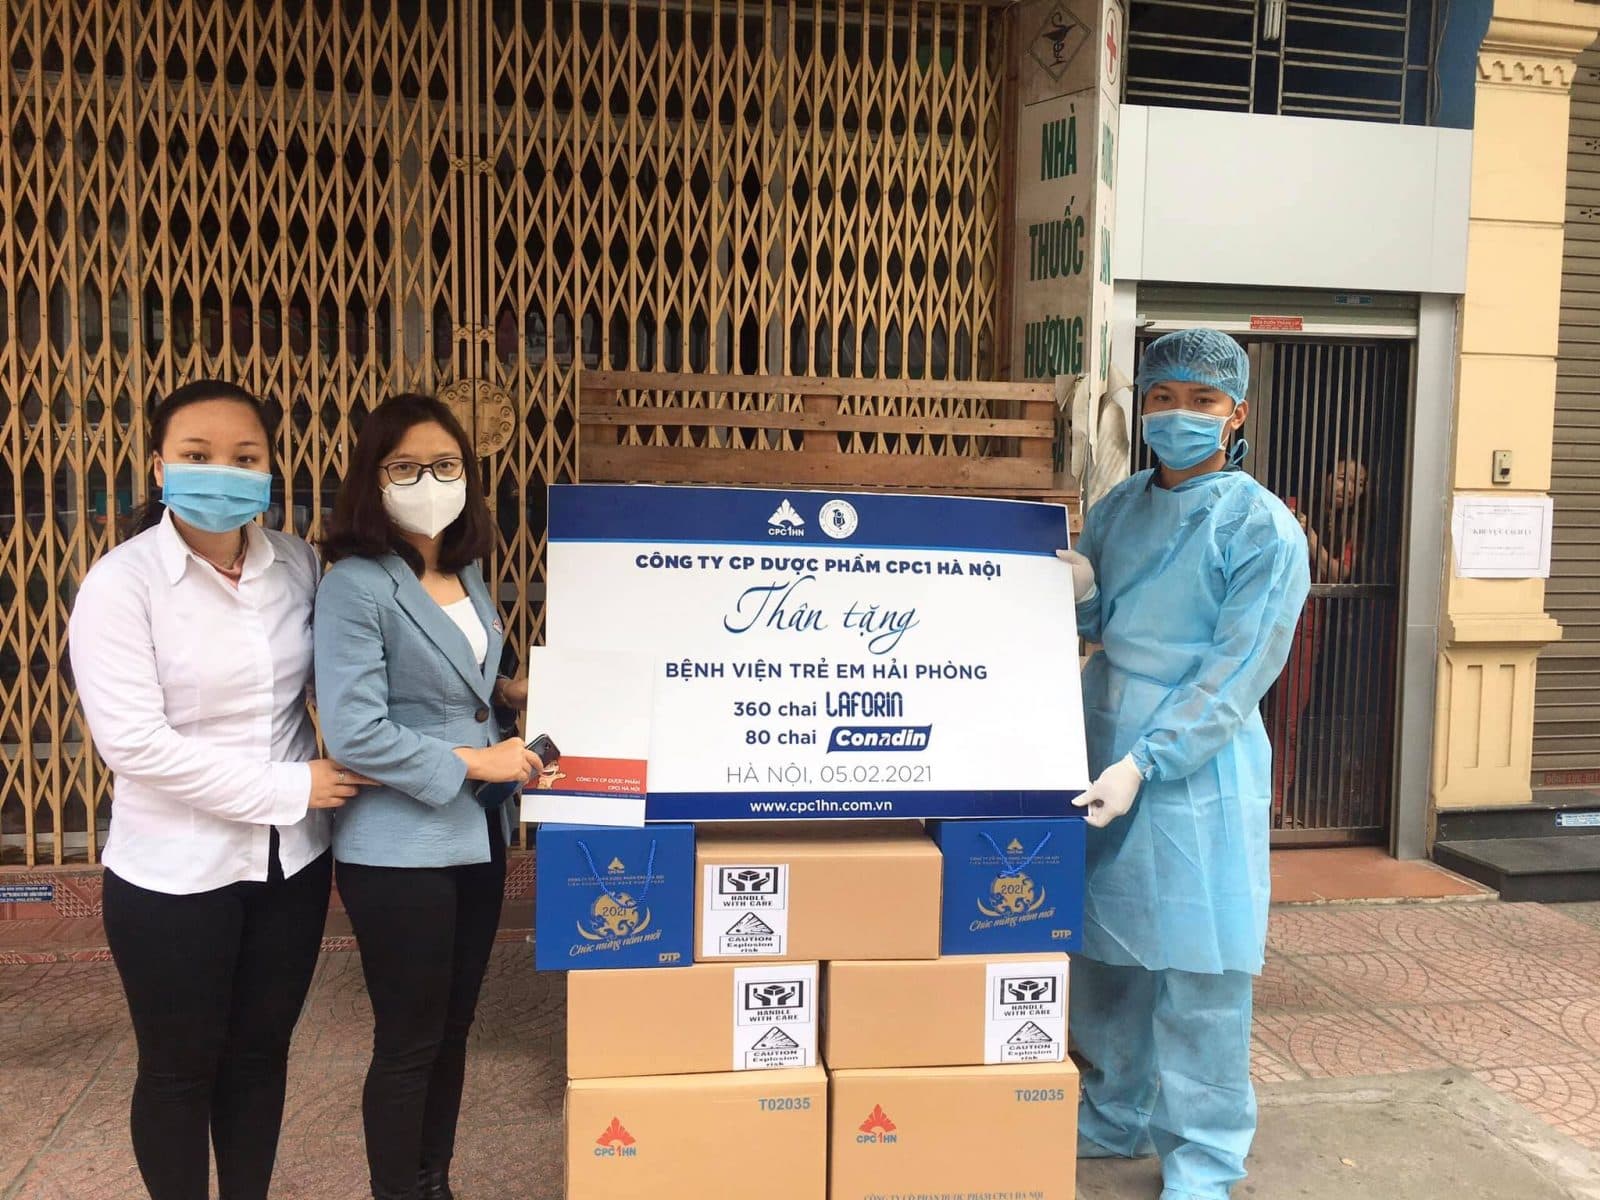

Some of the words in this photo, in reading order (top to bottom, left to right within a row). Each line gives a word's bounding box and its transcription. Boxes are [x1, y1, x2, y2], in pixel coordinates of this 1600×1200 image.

[1041, 103, 1077, 181] NHÀ
[1029, 195, 1085, 281] THUỐC
[1024, 315, 1084, 378] HƯƠNG
[768, 526, 804, 536] CPC1HN
[635, 552, 693, 569] CÔNG
[698, 555, 723, 570] TY
[729, 556, 755, 571] CP
[760, 555, 819, 576] DƯỢC
[885, 560, 932, 575] CPC1
[937, 558, 964, 576] HÀ
[969, 559, 1002, 581] NỘI
[723, 575, 829, 634] Thân
[843, 600, 921, 655] tặng
[665, 658, 725, 685] BỆNH
[731, 658, 782, 685] VIỆN
[789, 656, 830, 680] TRẺ
[836, 664, 865, 680] EM
[872, 658, 908, 680] HẢI
[915, 659, 988, 681] PHÒNG
[733, 701, 772, 717] 360
[778, 701, 817, 717] chai
[745, 730, 771, 745] 80
[777, 729, 817, 745] chai
[726, 762, 760, 784] HÀ
[767, 762, 813, 787] NỘI,
[820, 765, 932, 784] 05.02.2021
[750, 799, 892, 814] www.cpc1hn.com.vn
[1001, 884, 1024, 895] 2021
[602, 906, 627, 917] 2021
[969, 919, 993, 932] Chúc
[1051, 930, 1072, 939] DTP
[569, 943, 594, 957] Chúc
[595, 937, 621, 951] mừng
[622, 934, 644, 947] năm
[658, 952, 681, 962] DTP
[1015, 1089, 1065, 1102] T02035
[758, 1097, 811, 1111] T02035
[856, 1132, 897, 1144] CPC1HN
[594, 1145, 637, 1157] CPC1HN
